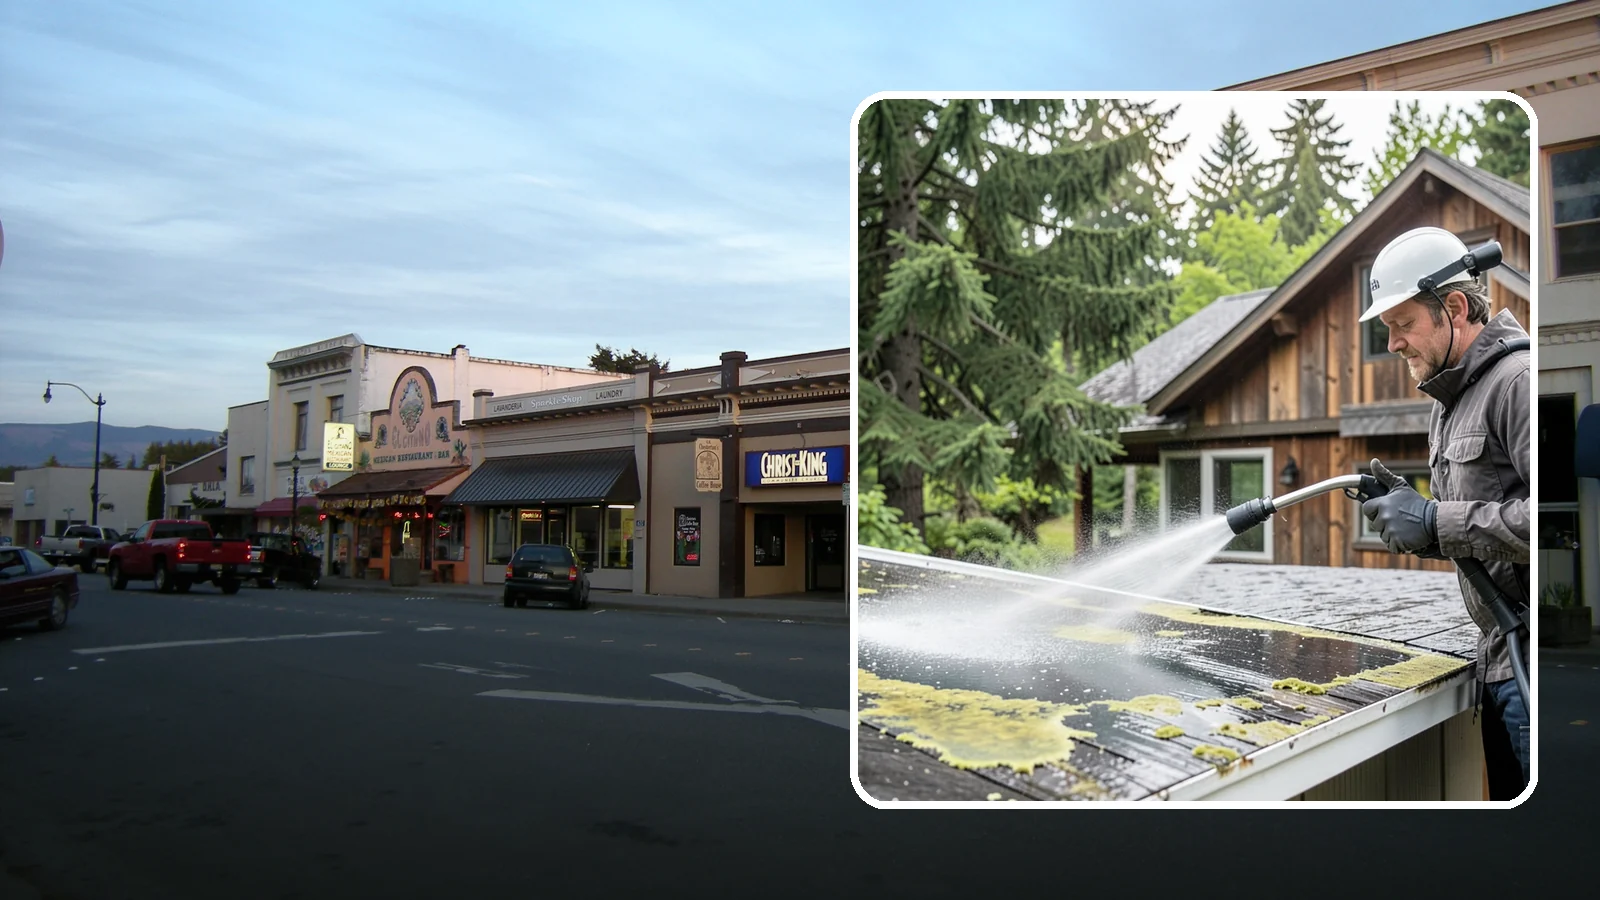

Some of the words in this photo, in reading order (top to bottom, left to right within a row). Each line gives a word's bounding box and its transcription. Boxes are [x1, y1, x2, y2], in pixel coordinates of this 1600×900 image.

[494, 402, 522, 413] LAVANDERIA
[531, 398, 560, 409] Sparkle
[562, 394, 582, 405] Shop
[596, 389, 624, 400] LAUNDRY
[374, 454, 396, 464] MEXICAN
[397, 451, 433, 463] RESTAURANT
[438, 450, 450, 459] BAR
[761, 453, 797, 477] CHRIST
[798, 450, 827, 476] KING
[697, 481, 709, 489] Coffee
[710, 481, 722, 489] House
